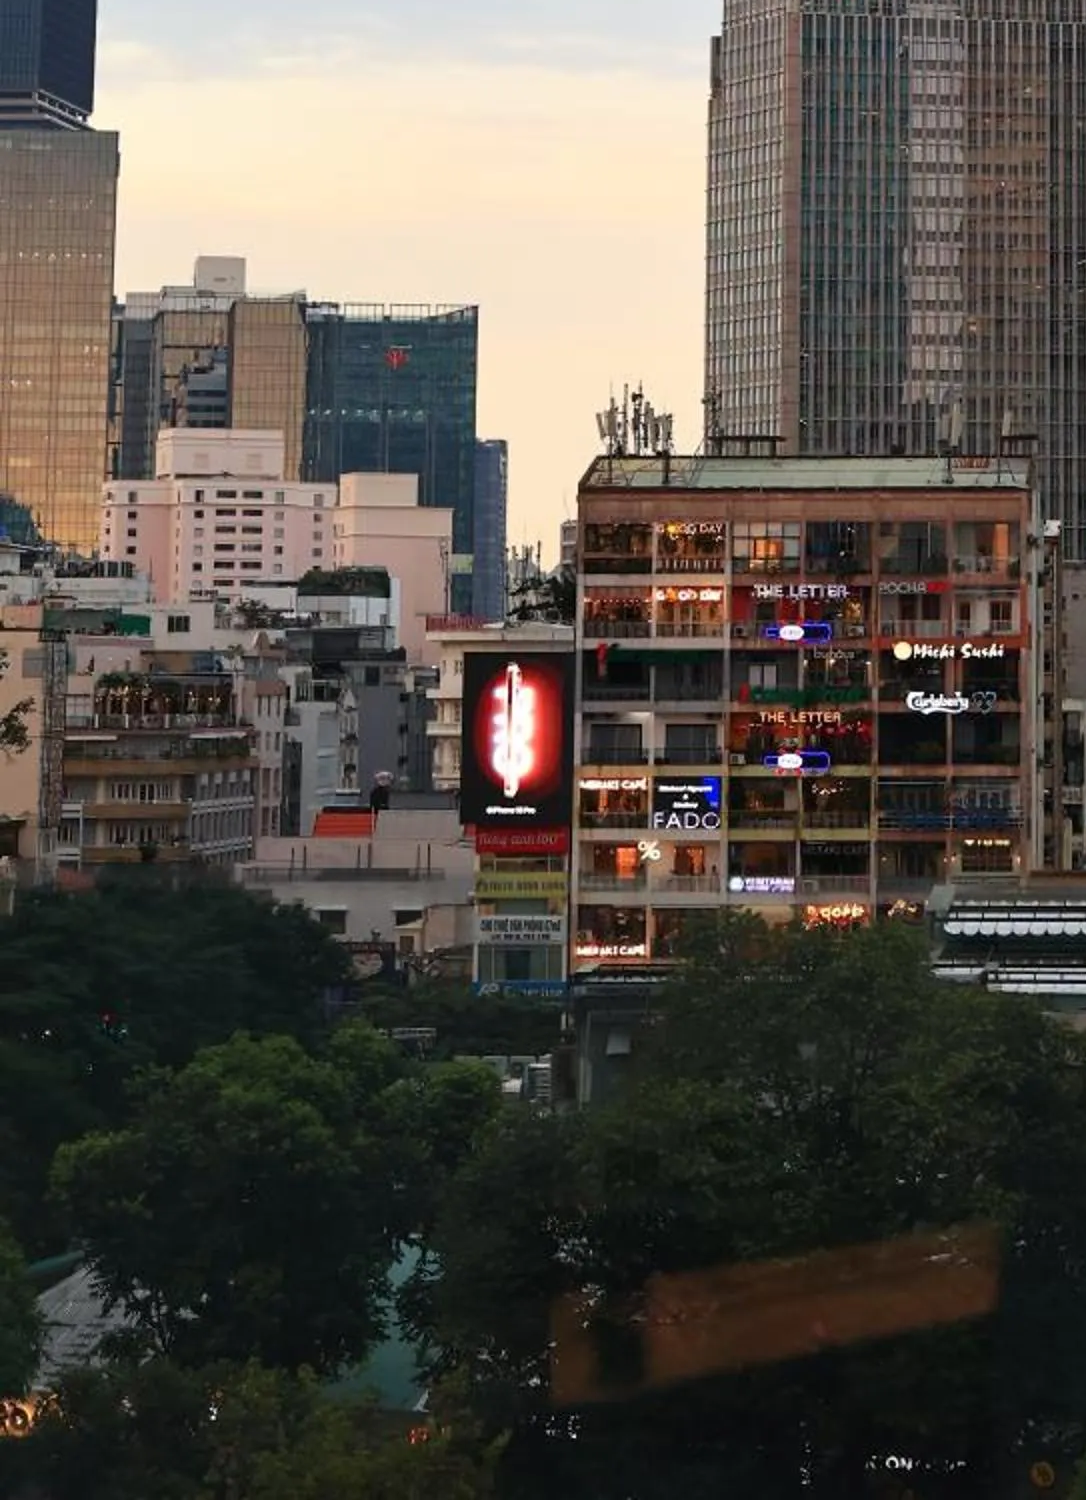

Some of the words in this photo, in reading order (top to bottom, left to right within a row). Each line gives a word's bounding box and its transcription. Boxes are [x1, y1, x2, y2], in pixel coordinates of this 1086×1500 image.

[753, 583, 785, 599] THE
[789, 583, 849, 599] LETTER
[913, 643, 955, 659] Michi
[960, 641, 1004, 659] Sushi
[905, 691, 969, 715] Carlsberg
[760, 711, 785, 723] THE
[791, 711, 842, 724] LETTER
[653, 811, 721, 829] FADO
